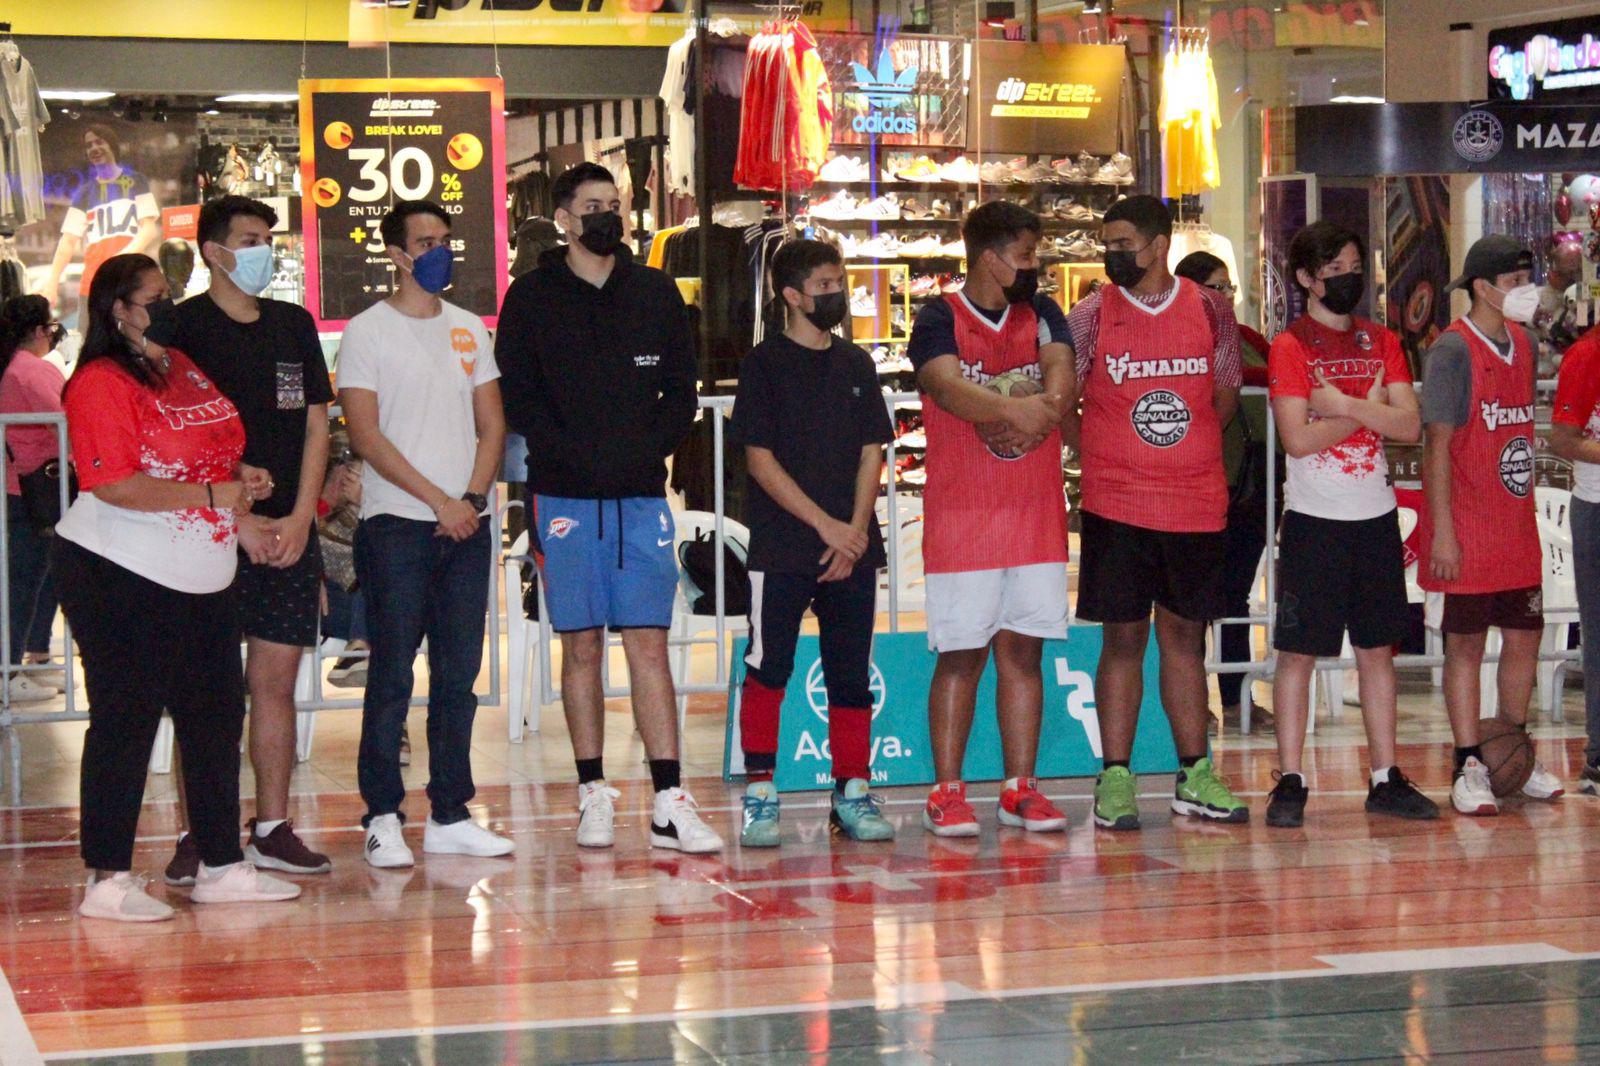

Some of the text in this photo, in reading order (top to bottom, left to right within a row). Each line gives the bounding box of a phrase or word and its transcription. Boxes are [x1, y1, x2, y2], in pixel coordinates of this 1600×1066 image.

[852, 111, 917, 133] adidas
[365, 125, 442, 135] BREAK LOVE!
[347, 147, 434, 202] 30
[441, 173, 461, 191] %
[441, 191, 463, 201] OFF
[349, 207, 364, 216] EN
[366, 206, 380, 216] TU
[1106, 352, 1208, 384] VENADOS
[1143, 394, 1174, 403] PURO
[1133, 410, 1188, 422] SINALOA
[1140, 427, 1184, 443] CALIDAD
